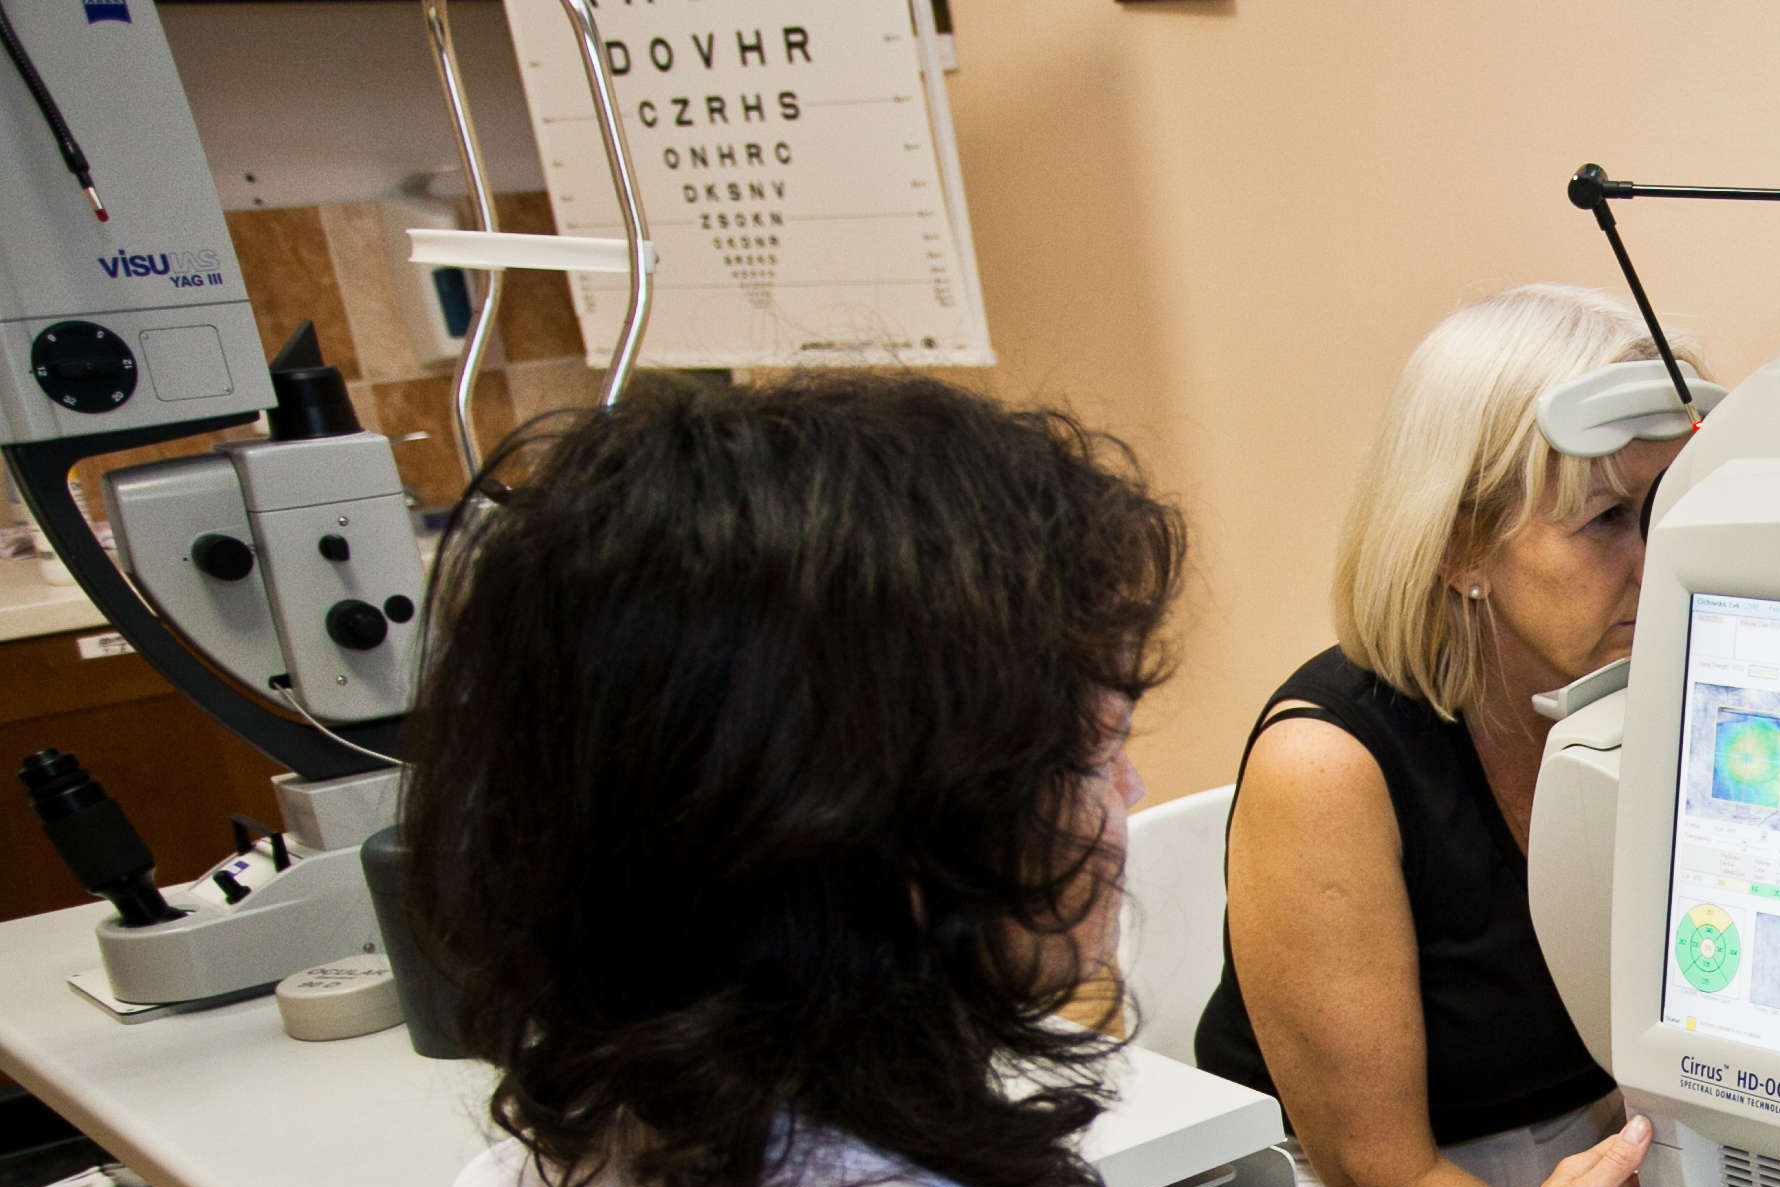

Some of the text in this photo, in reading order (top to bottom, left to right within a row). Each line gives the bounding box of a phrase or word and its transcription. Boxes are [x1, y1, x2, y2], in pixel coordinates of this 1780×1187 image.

[638, 91, 801, 128] CZRHS
[663, 142, 792, 170] ONHRC
[683, 182, 787, 203] DKSNV
[169, 272, 223, 288] YAG III
[1680, 1079, 1713, 1095] SPECTRAL
[1716, 1090, 1745, 1104] DOMAIN
